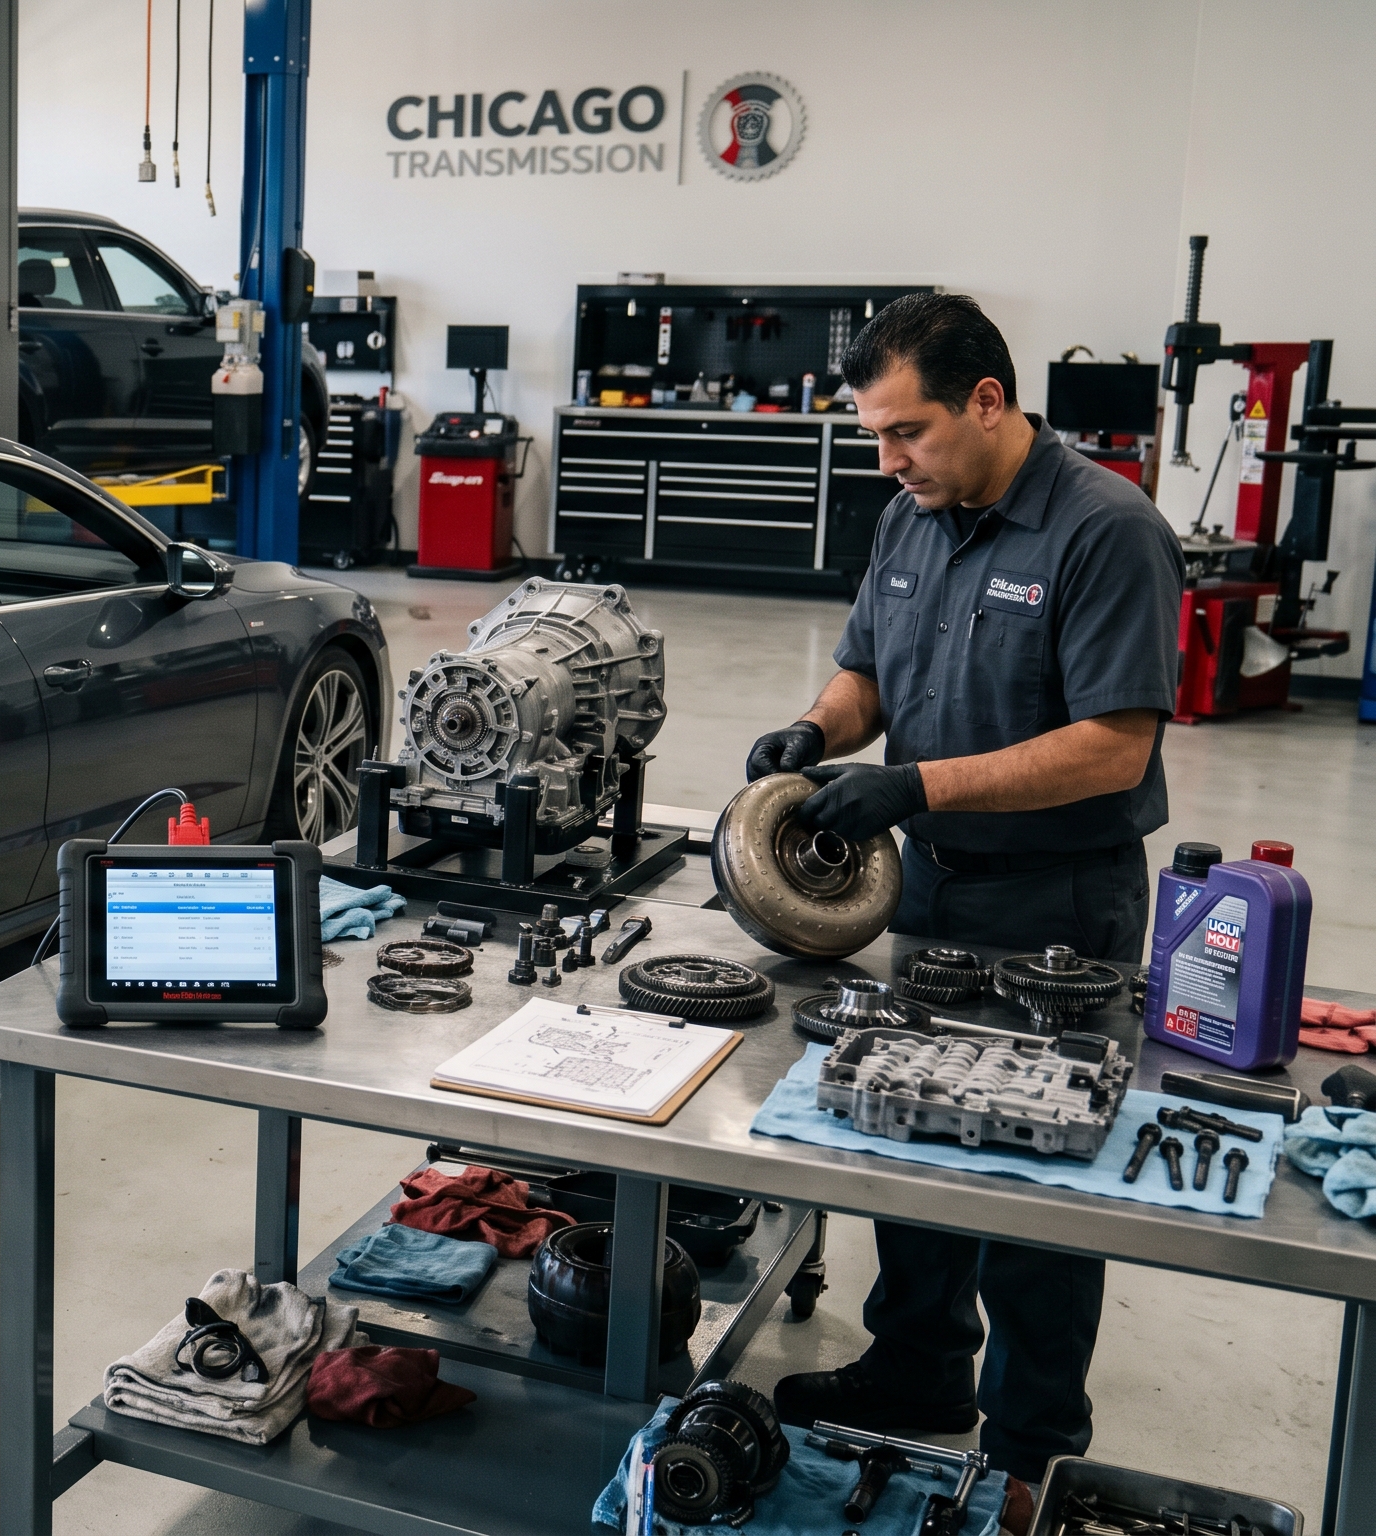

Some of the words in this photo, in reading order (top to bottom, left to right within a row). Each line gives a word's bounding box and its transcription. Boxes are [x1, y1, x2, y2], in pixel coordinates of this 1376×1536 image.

[386, 86, 666, 141] CHICAGO
[386, 143, 665, 178] TRANSMISSION
[428, 471, 484, 487] Snap-on
[1209, 919, 1240, 938] LIQUI
[1207, 932, 1239, 950] MOLY
